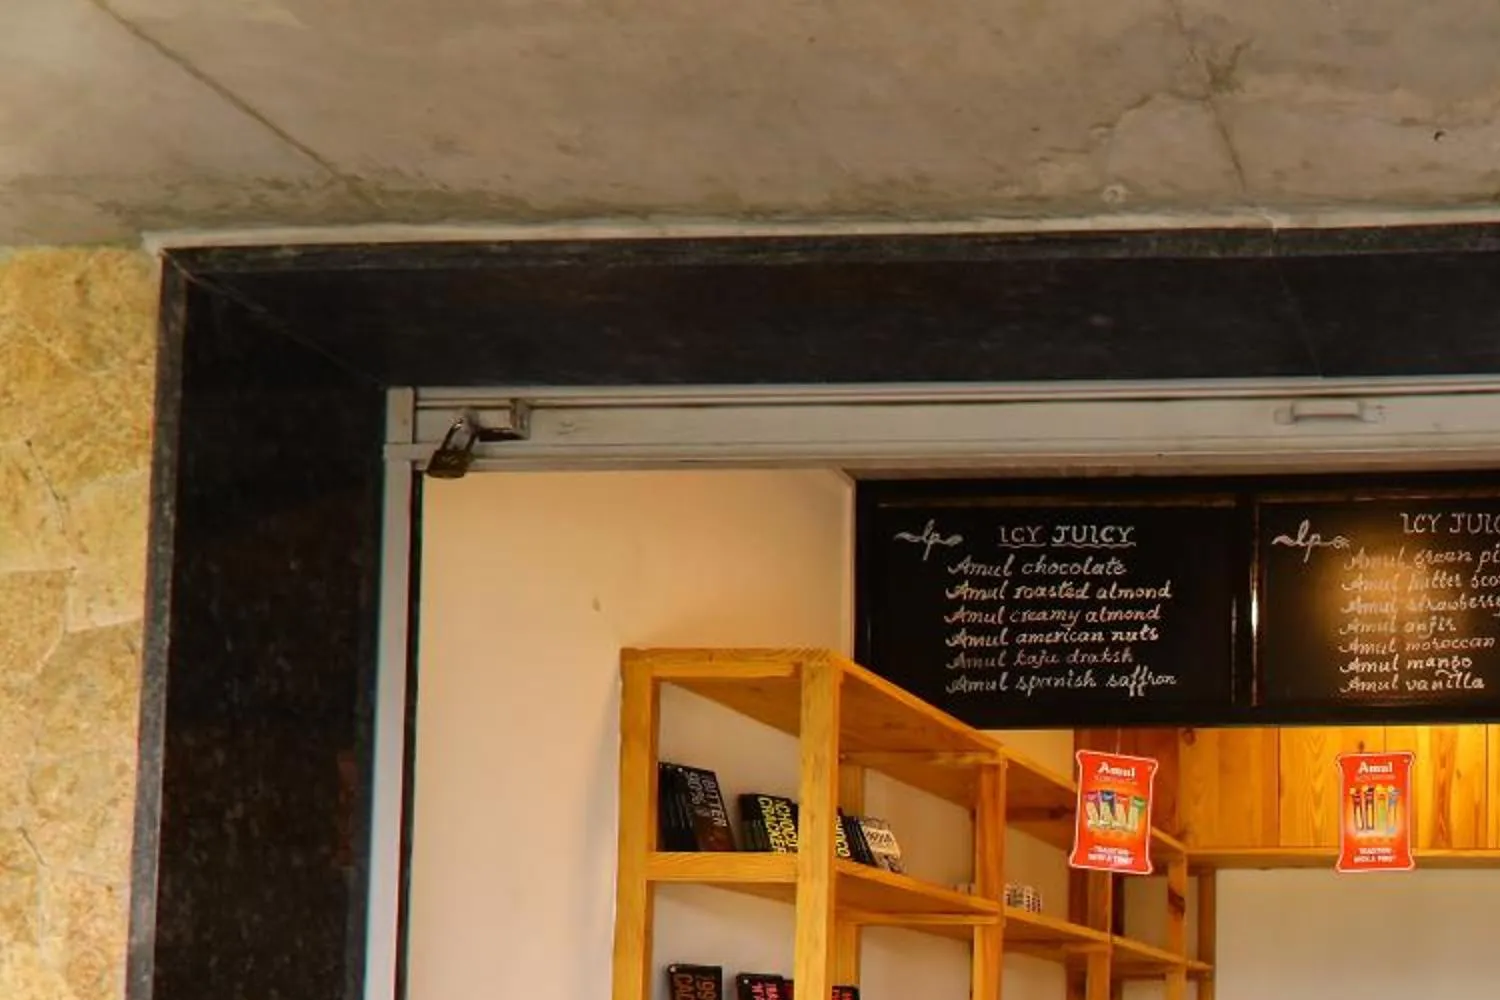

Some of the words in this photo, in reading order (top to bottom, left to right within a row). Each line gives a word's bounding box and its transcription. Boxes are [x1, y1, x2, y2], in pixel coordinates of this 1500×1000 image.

[1400, 512, 1441, 534] ICY
[999, 525, 1043, 545] ICY
[1051, 525, 1136, 545] JUICY
[946, 553, 1013, 576] Amul
[1021, 554, 1127, 576] chocolate
[945, 579, 1005, 600] Amul
[1013, 580, 1089, 600] roasted
[1096, 579, 1172, 600] almond
[944, 605, 1004, 625] Amul
[1010, 608, 1082, 632] creamy
[1085, 604, 1161, 622] almond
[1340, 618, 1398, 636] Amul
[945, 627, 1008, 648] Amul
[1015, 630, 1104, 645] american
[1111, 623, 1160, 642] nuts
[1339, 637, 1397, 656] Amul
[945, 651, 1006, 670] Amul
[1340, 655, 1399, 674] Amul
[1406, 656, 1473, 678] mango
[945, 670, 1009, 694] Amul
[1106, 664, 1178, 697] saffron
[1340, 673, 1399, 694] Amul
[1405, 673, 1485, 693] vanilla
